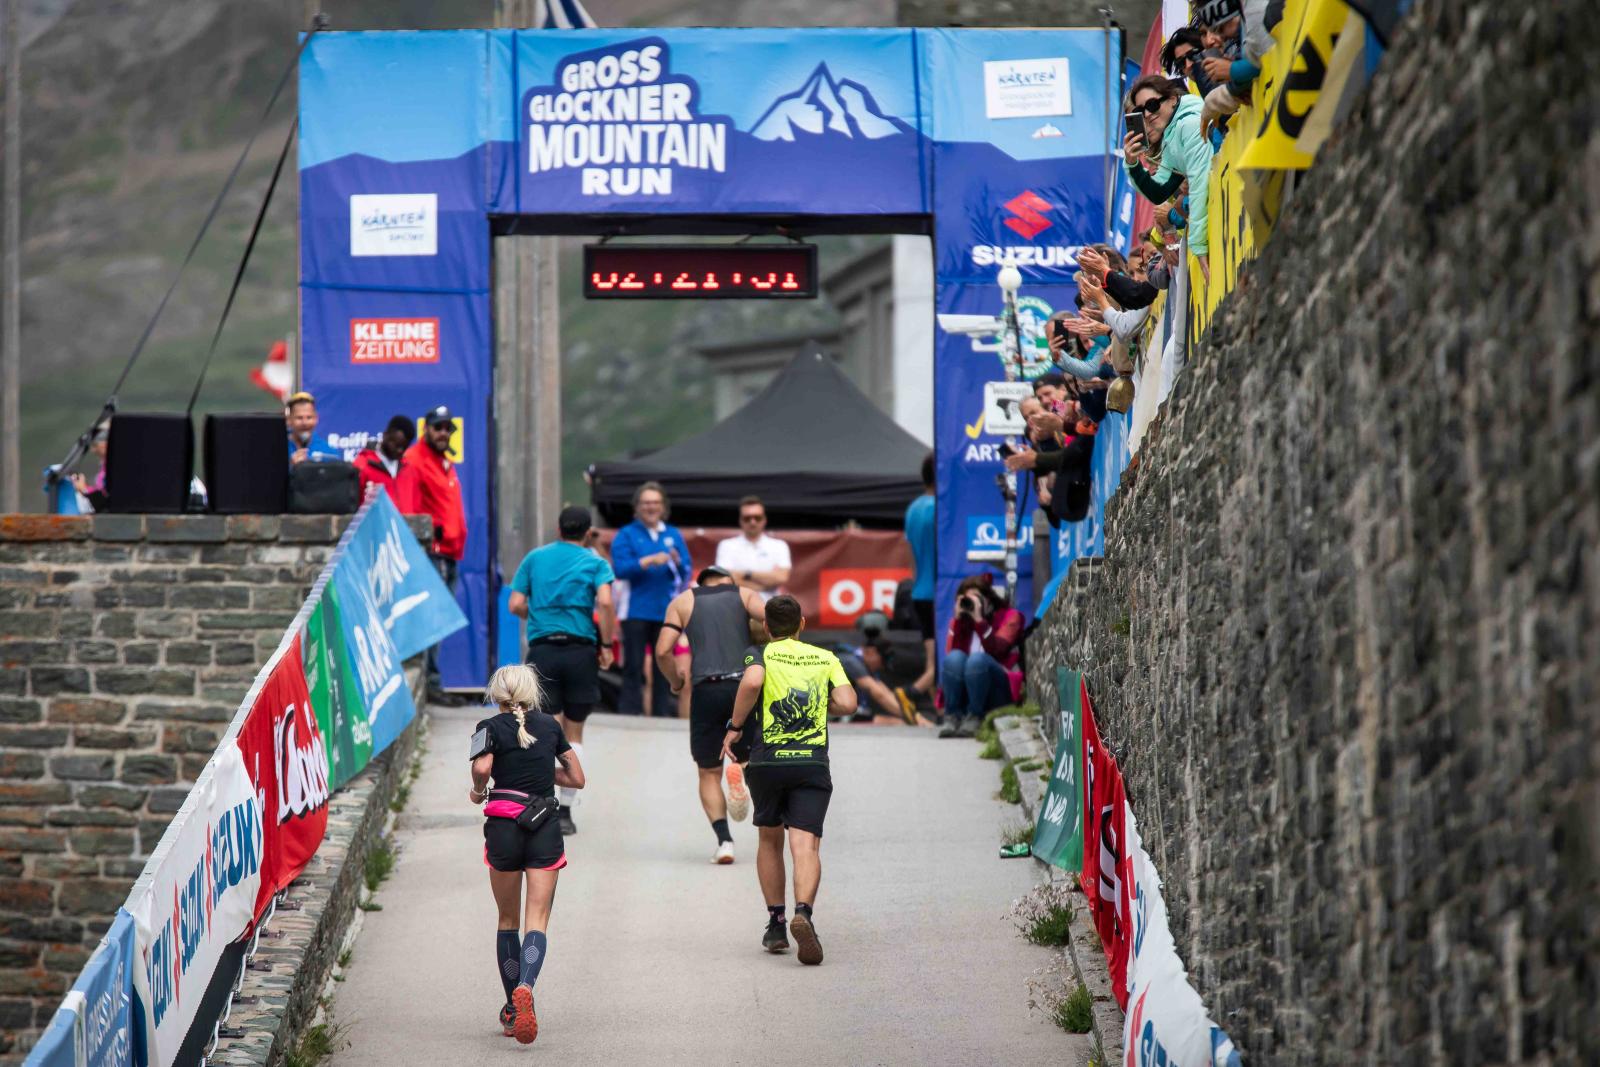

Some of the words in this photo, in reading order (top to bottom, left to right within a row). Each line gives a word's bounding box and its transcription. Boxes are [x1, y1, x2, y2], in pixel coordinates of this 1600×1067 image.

[562, 45, 662, 93] GROSS
[529, 82, 693, 122] GLOCKNER
[529, 122, 726, 173] MOUNTAIN
[582, 168, 672, 195] RUN
[972, 244, 1084, 267] SUZUK
[354, 322, 435, 340] KLEINE
[355, 341, 436, 360] ZEITUNG
[829, 578, 898, 615] OR
